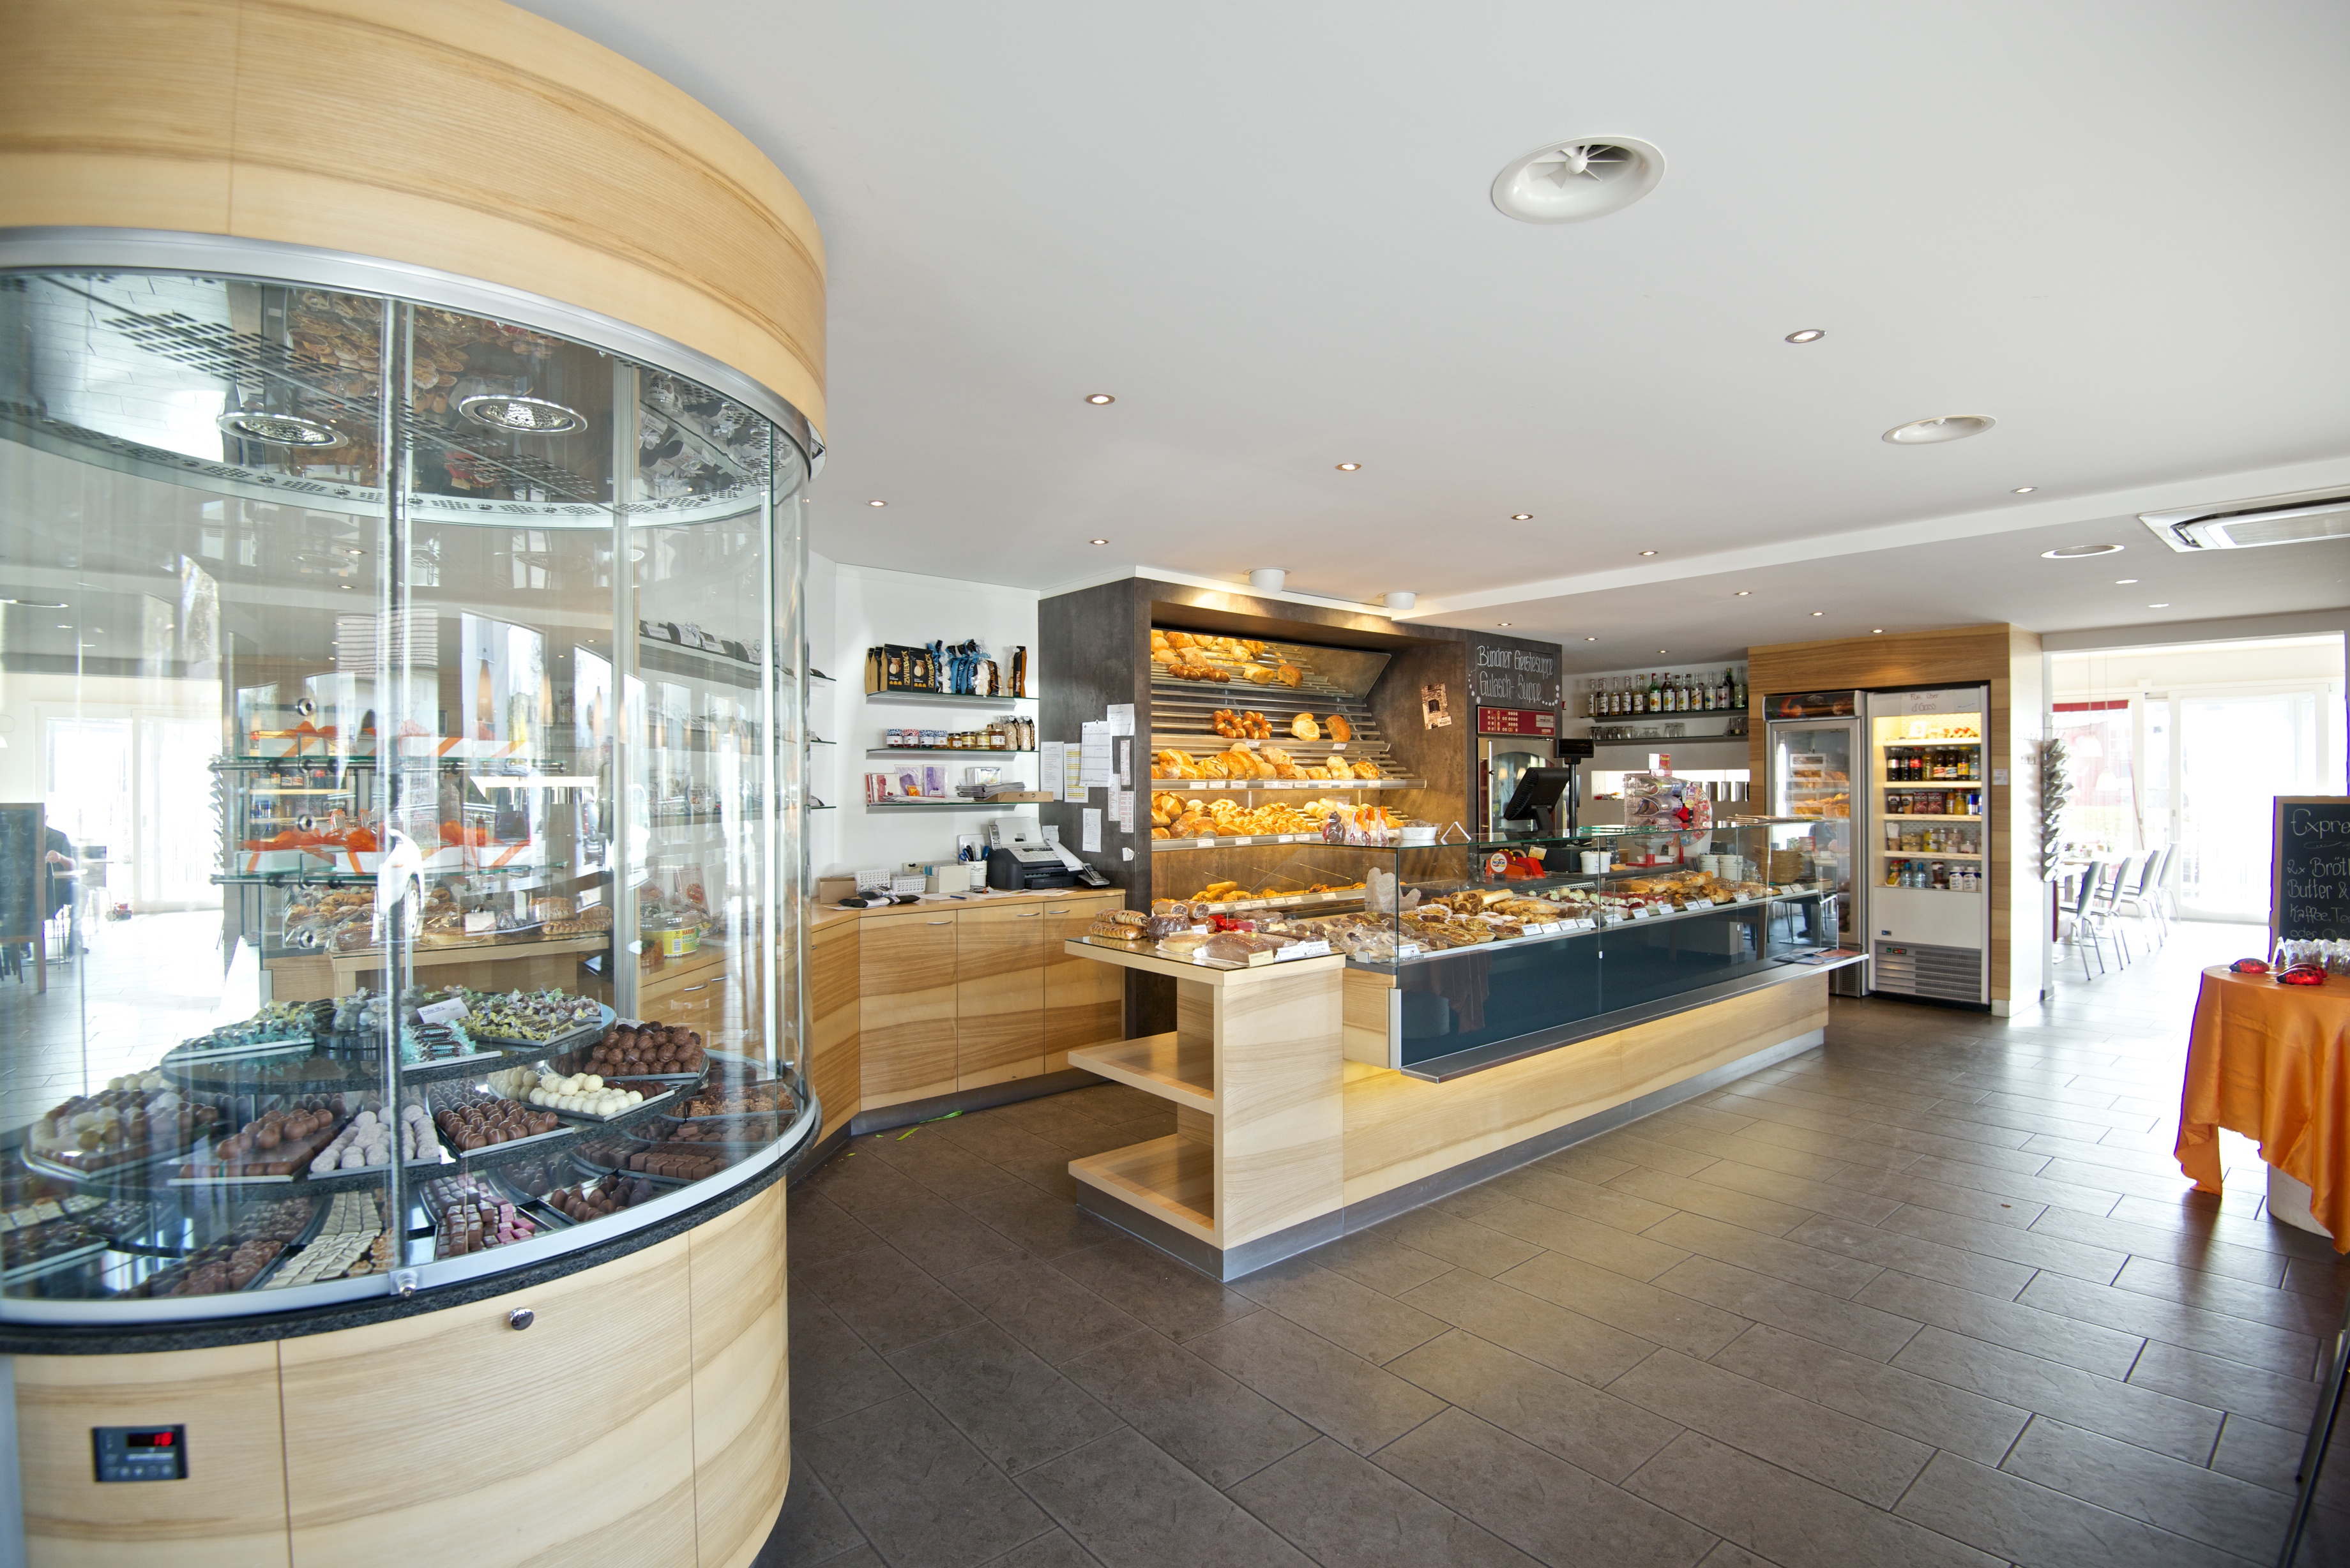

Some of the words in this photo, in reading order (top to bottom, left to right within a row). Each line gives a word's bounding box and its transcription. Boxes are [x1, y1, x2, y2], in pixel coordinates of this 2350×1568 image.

[901, 650, 910, 685] ZWIEBACK
[924, 653, 935, 688] ZWIEBACK
[1477, 645, 1512, 669] Bündner
[1514, 650, 1554, 680] Gerstesuppe
[1518, 674, 1542, 703] Suppe
[2291, 808, 2350, 839] Expre
[2287, 859, 2306, 875] 2x
[2287, 878, 2333, 899] Butter
[2339, 881, 2349, 900] &
[2290, 927, 2317, 939] oder
